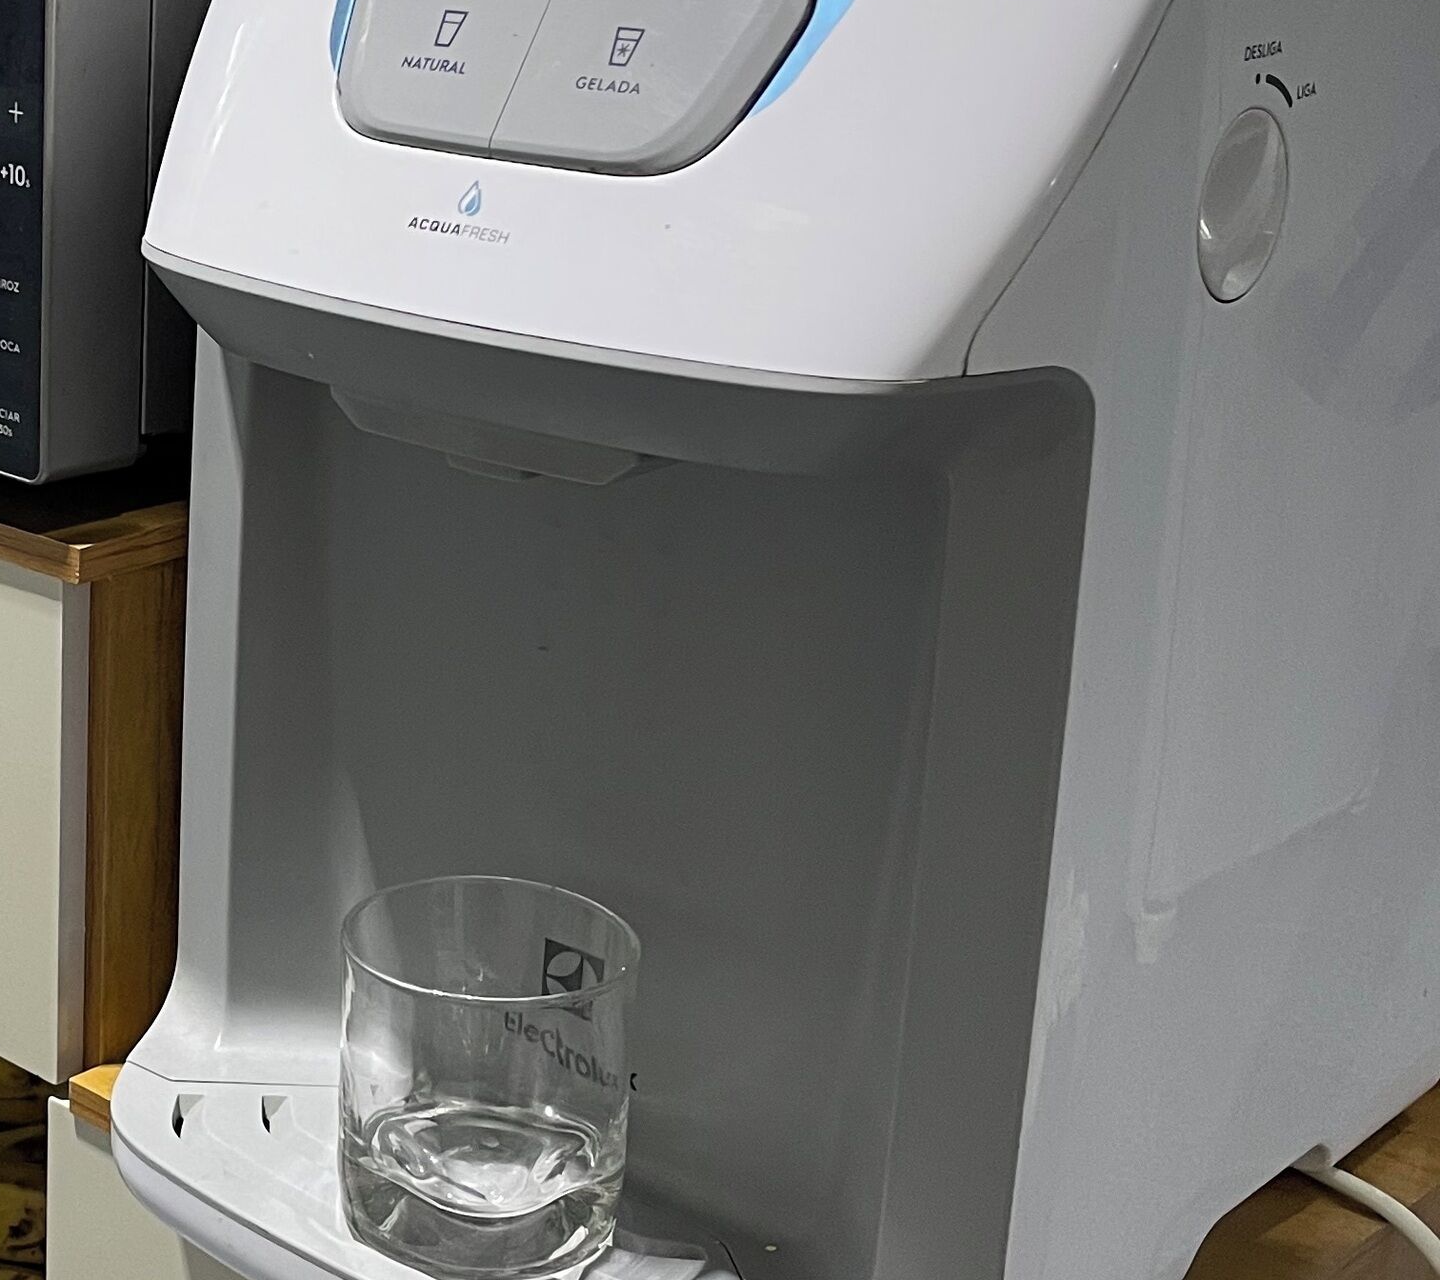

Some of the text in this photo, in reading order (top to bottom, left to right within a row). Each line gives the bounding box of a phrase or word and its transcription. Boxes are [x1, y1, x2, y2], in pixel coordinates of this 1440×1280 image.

[1244, 40, 1283, 61] DESLIGA
[401, 56, 466, 75] NATURAL
[575, 76, 641, 95] GELADA
[1297, 81, 1317, 100] LIGA
[408, 217, 511, 245] ACQUAFRESH
